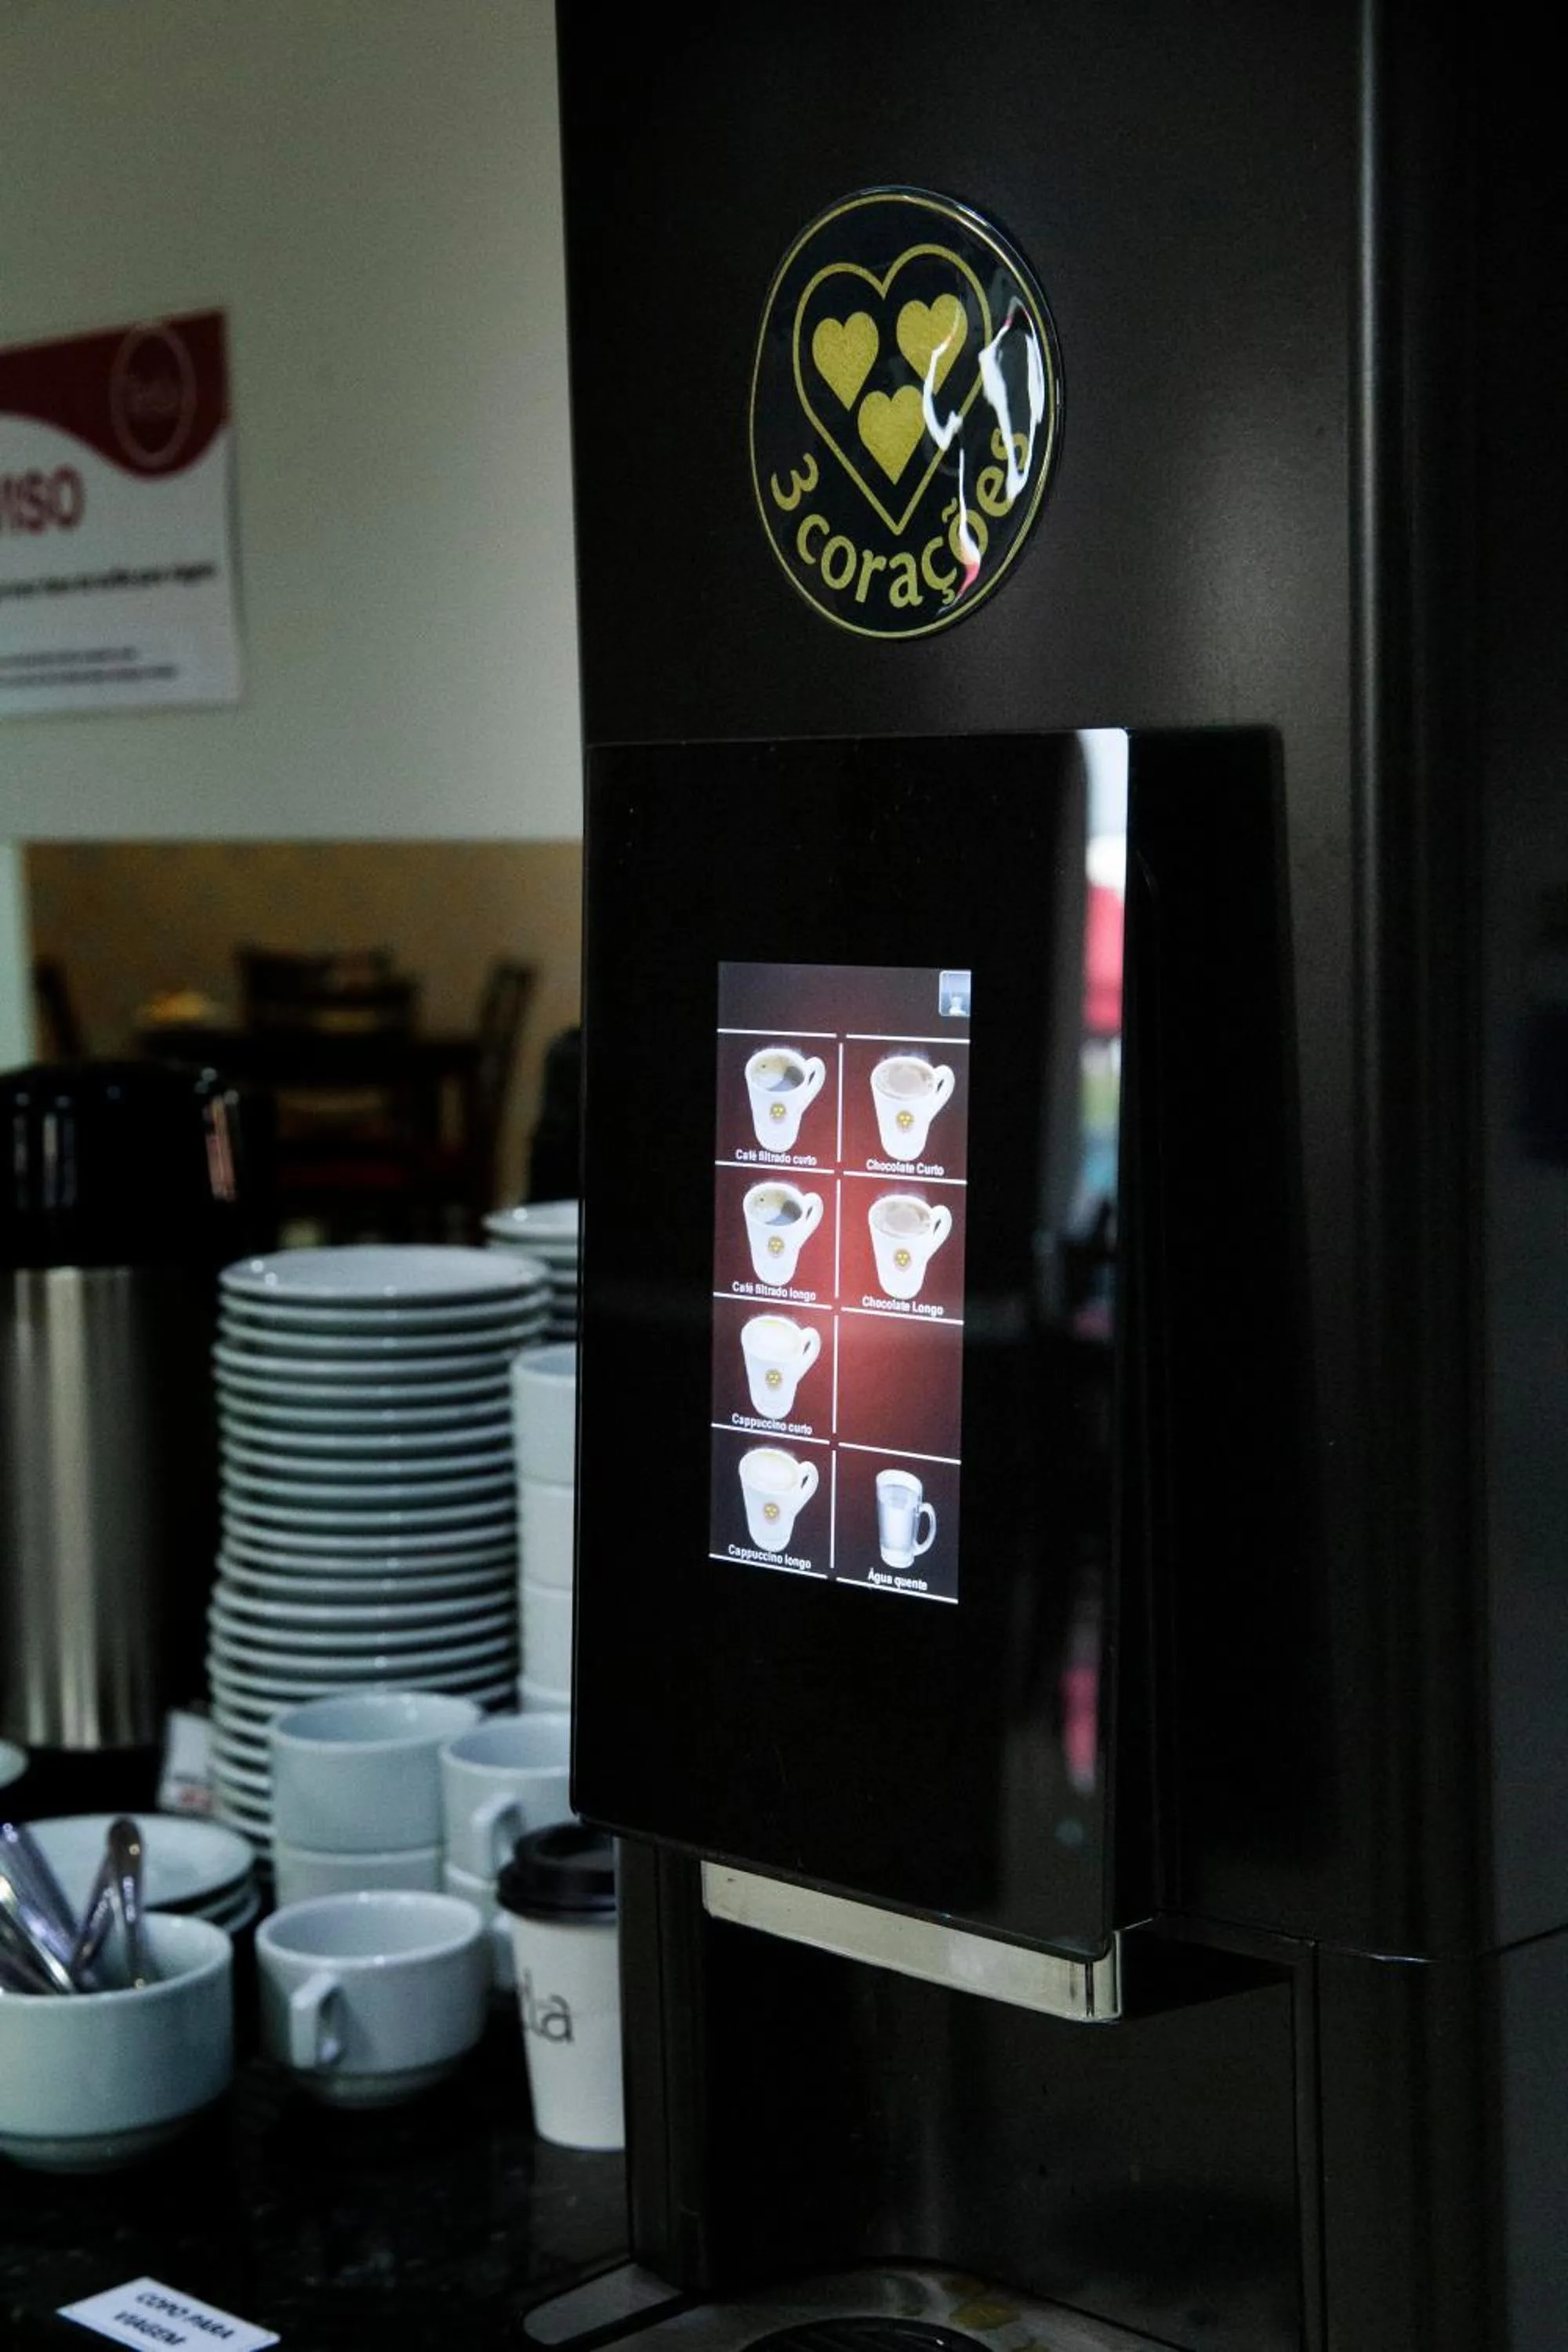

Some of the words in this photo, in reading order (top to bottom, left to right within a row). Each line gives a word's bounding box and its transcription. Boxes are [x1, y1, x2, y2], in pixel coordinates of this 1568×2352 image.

[770, 452, 818, 511] 3
[735, 1149, 757, 1161] Café
[758, 1150, 791, 1164] filtrado
[793, 1155, 817, 1166] curto
[866, 1159, 915, 1174] Chocolate
[916, 1163, 944, 1177] Curto
[732, 1281, 753, 1294] Café
[755, 1283, 788, 1298] filtrado
[789, 1287, 816, 1302] longo
[862, 1295, 910, 1311] Chocolate
[912, 1301, 944, 1317] Longo
[731, 1413, 786, 1432] Cappuccino
[788, 1422, 813, 1436] curto
[728, 1544, 783, 1564] Cappuccino
[785, 1553, 811, 1570] longo
[868, 1567, 893, 1584] Água
[894, 1577, 927, 1591] quente
